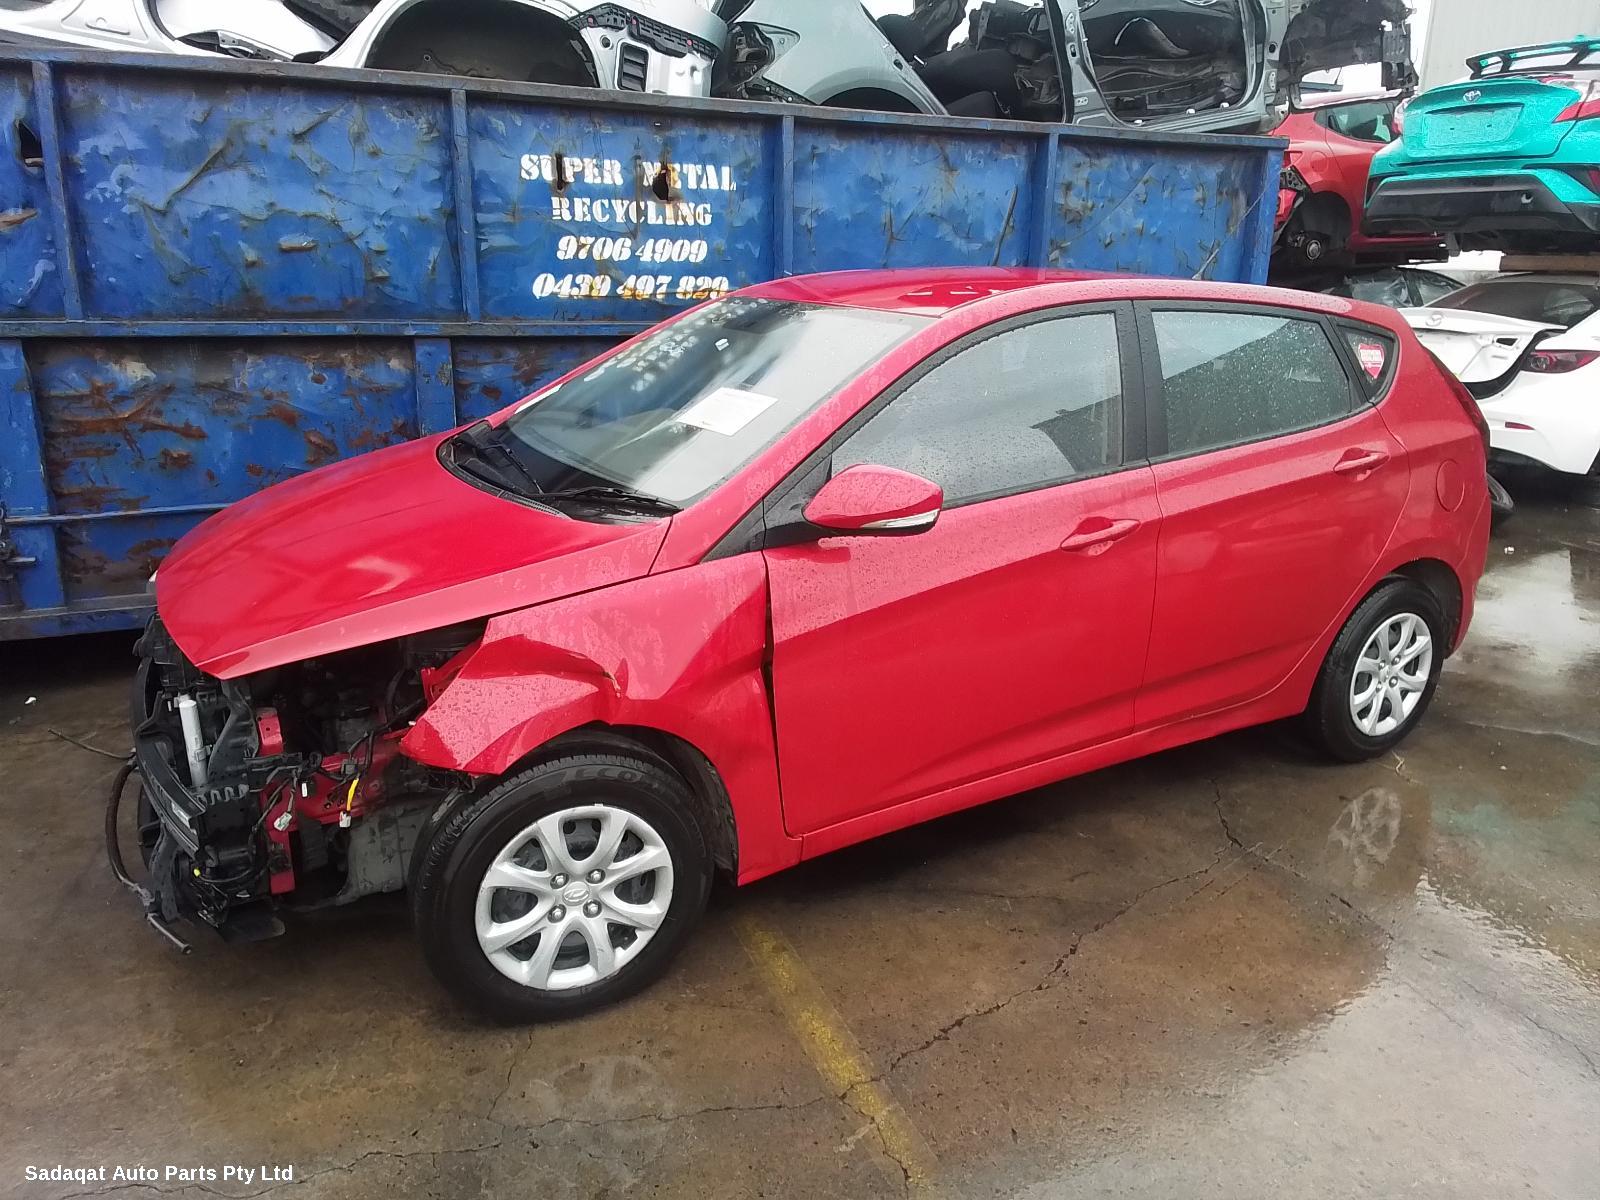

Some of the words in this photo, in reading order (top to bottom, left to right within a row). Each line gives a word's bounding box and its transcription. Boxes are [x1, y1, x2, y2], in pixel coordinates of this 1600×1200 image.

[520, 154, 624, 185] SUPER
[551, 197, 712, 225] RECYCLING
[556, 235, 632, 261] 9706
[635, 238, 708, 263] 4909
[532, 273, 611, 299] 0439
[616, 275, 673, 300] 497
